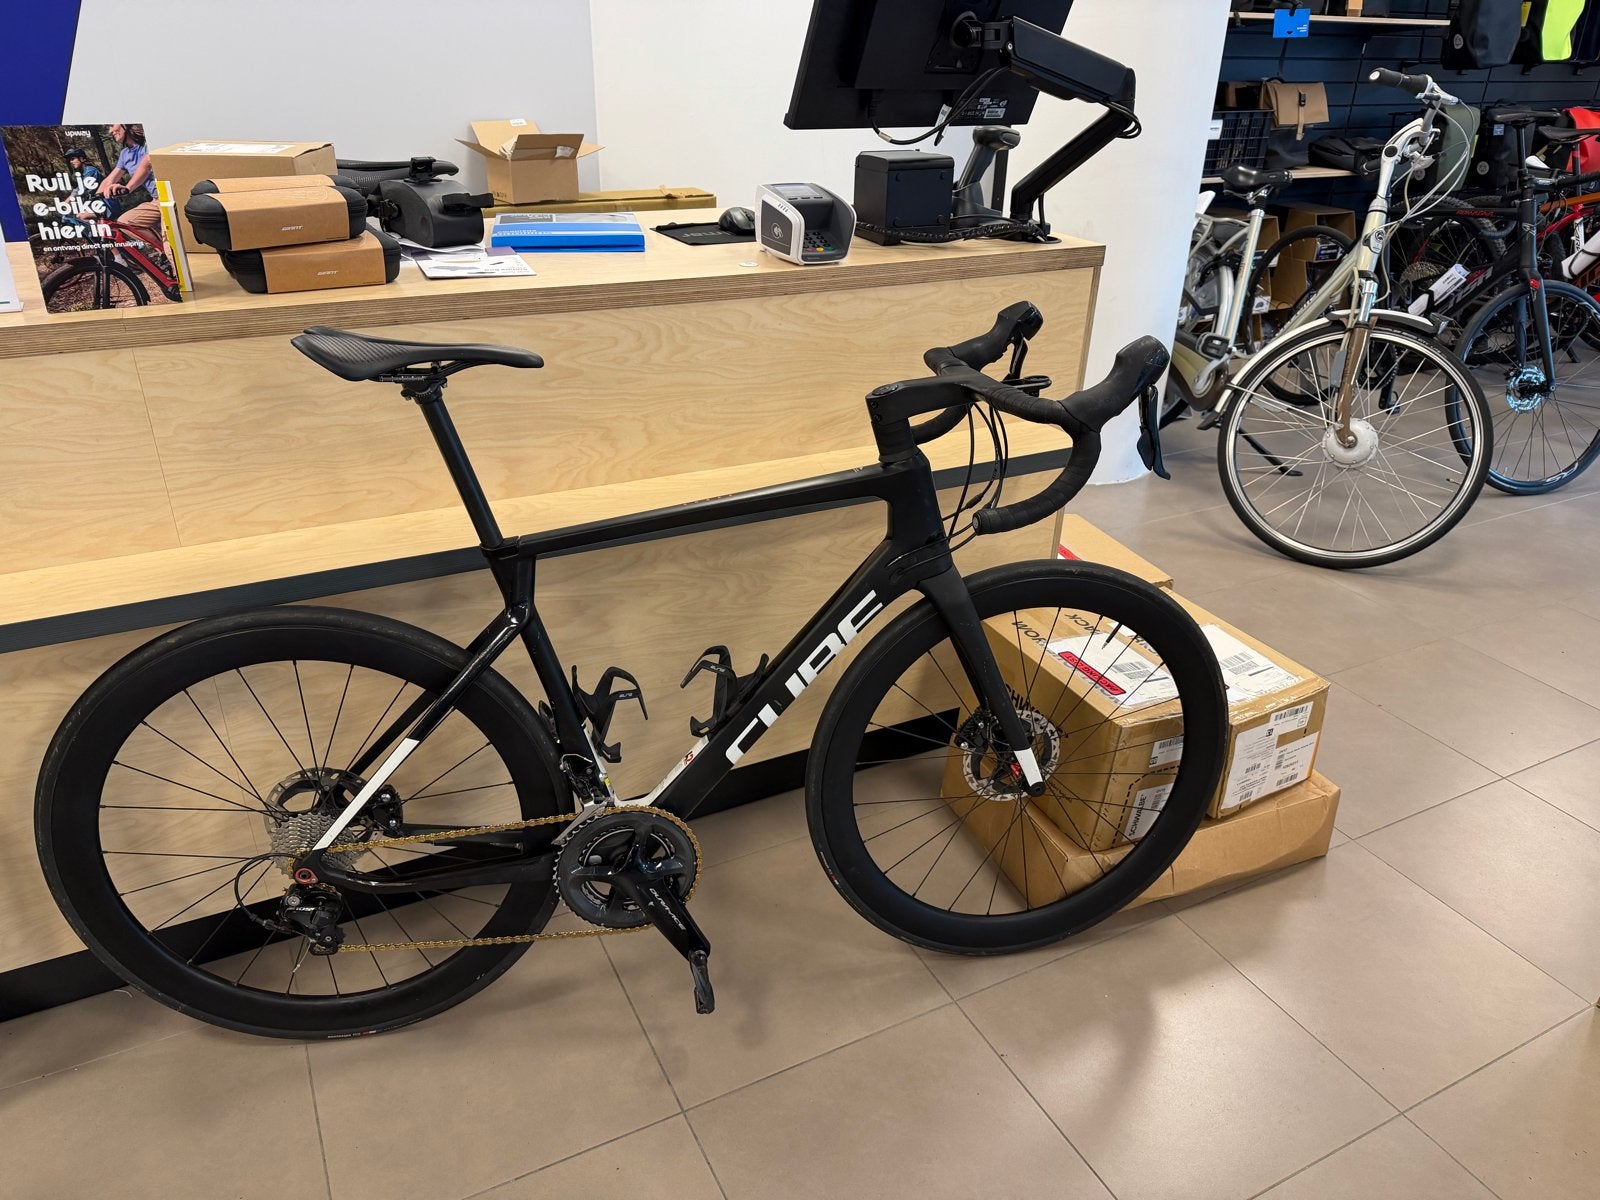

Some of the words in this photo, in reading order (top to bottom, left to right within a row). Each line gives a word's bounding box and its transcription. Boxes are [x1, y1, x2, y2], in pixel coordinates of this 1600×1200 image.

[64, 130, 91, 138] upway
[25, 173, 71, 193] Ruil
[74, 172, 99, 195] je
[33, 197, 107, 216] e-bike
[37, 220, 85, 240] hier
[90, 219, 112, 238] in
